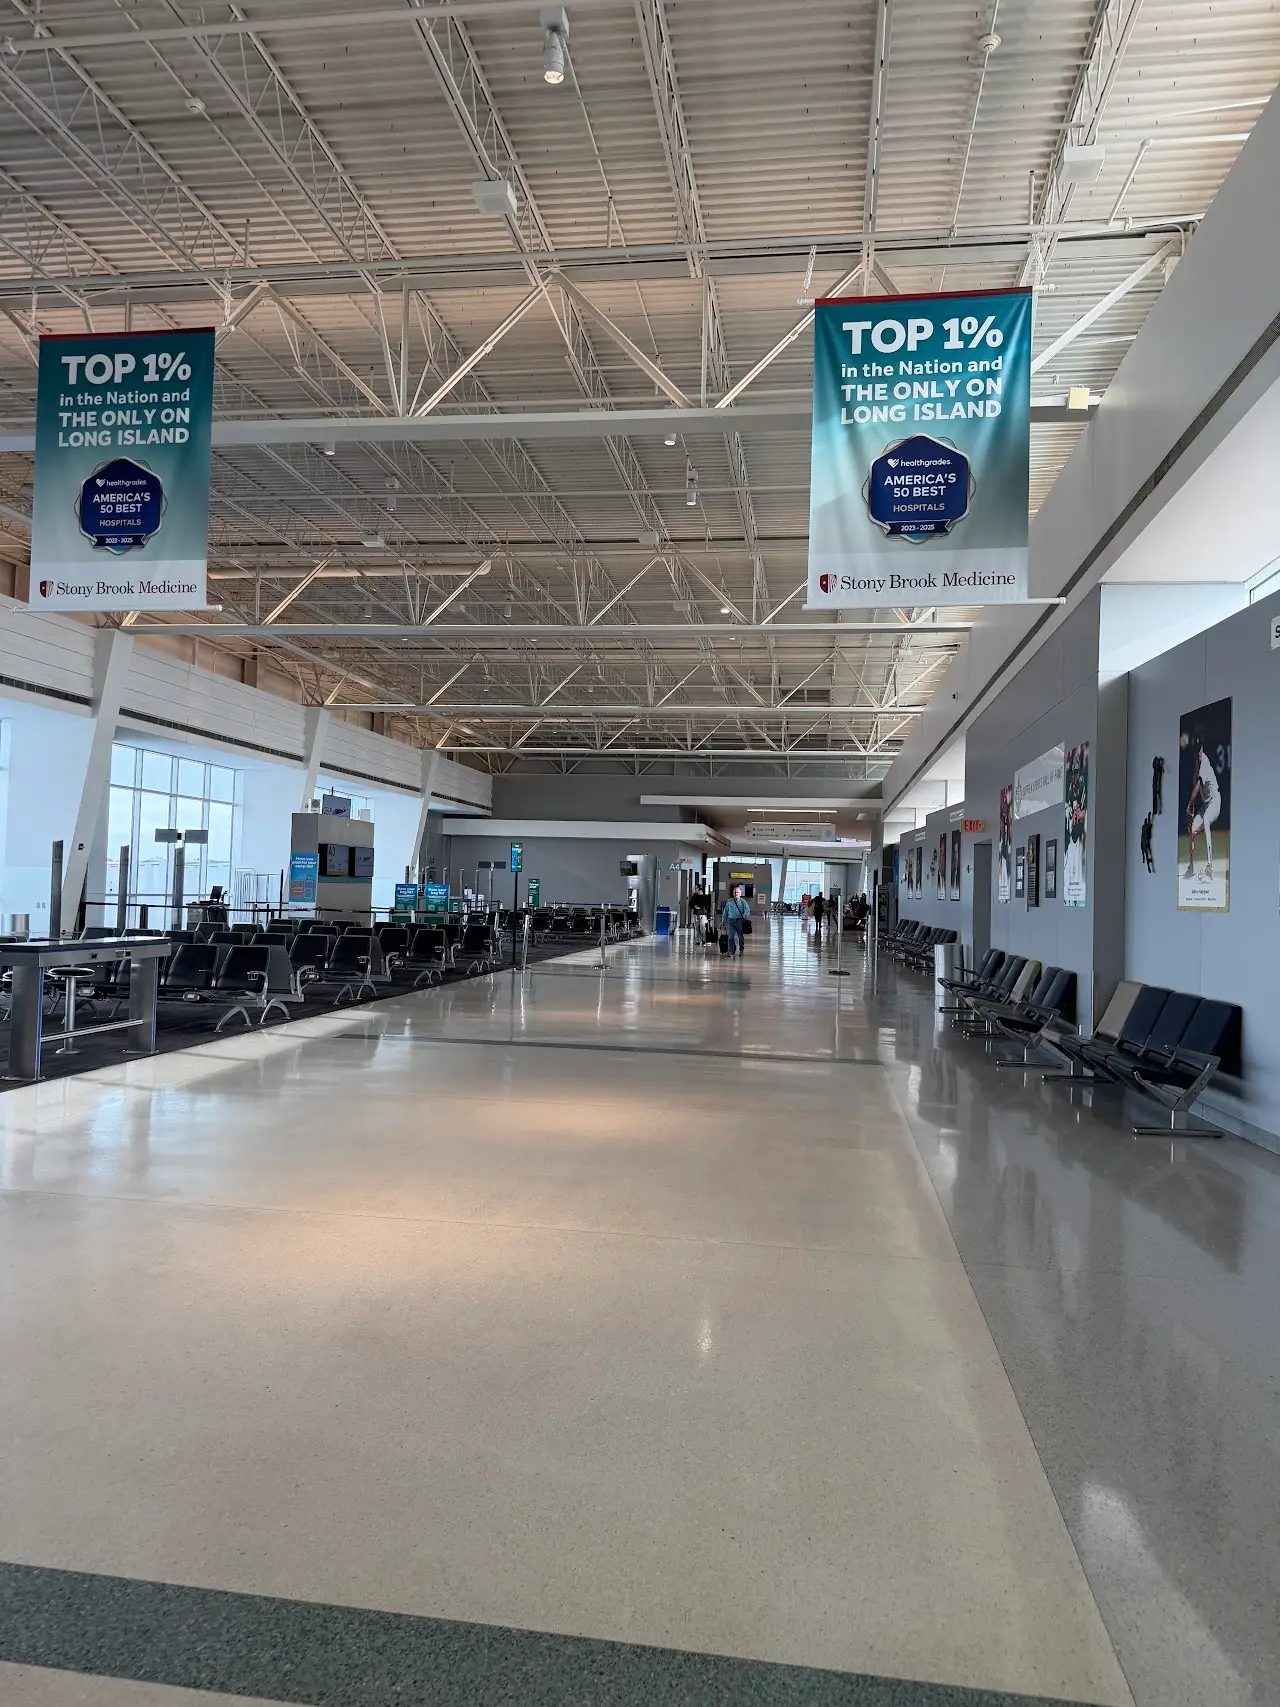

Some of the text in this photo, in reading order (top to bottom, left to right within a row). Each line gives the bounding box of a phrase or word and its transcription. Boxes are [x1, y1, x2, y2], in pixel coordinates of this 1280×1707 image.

[842, 316, 1004, 355] TOP 1%
[62, 352, 192, 385] TOP 1%
[841, 356, 1003, 378] in the Nation and
[60, 388, 190, 407] in the Nation and
[840, 378, 1002, 402] THE ONLY ON
[59, 408, 190, 428] THE ONLY ON
[840, 400, 1002, 425] LONG ISLAND
[58, 427, 189, 447] LONG ISLAND
[884, 473, 956, 486] AMERICA'S
[93, 492, 150, 503] AMERICA'S
[894, 486, 946, 498] 50 BEST
[100, 504, 142, 513] 50 BEST
[893, 503, 945, 512] HOSPITALS
[56, 580, 197, 598] Stony Brook Medicine
[840, 572, 1016, 592] Stony Brook Medicine
[964, 820, 979, 832] EXIT
[329, 846, 336, 857] A3
